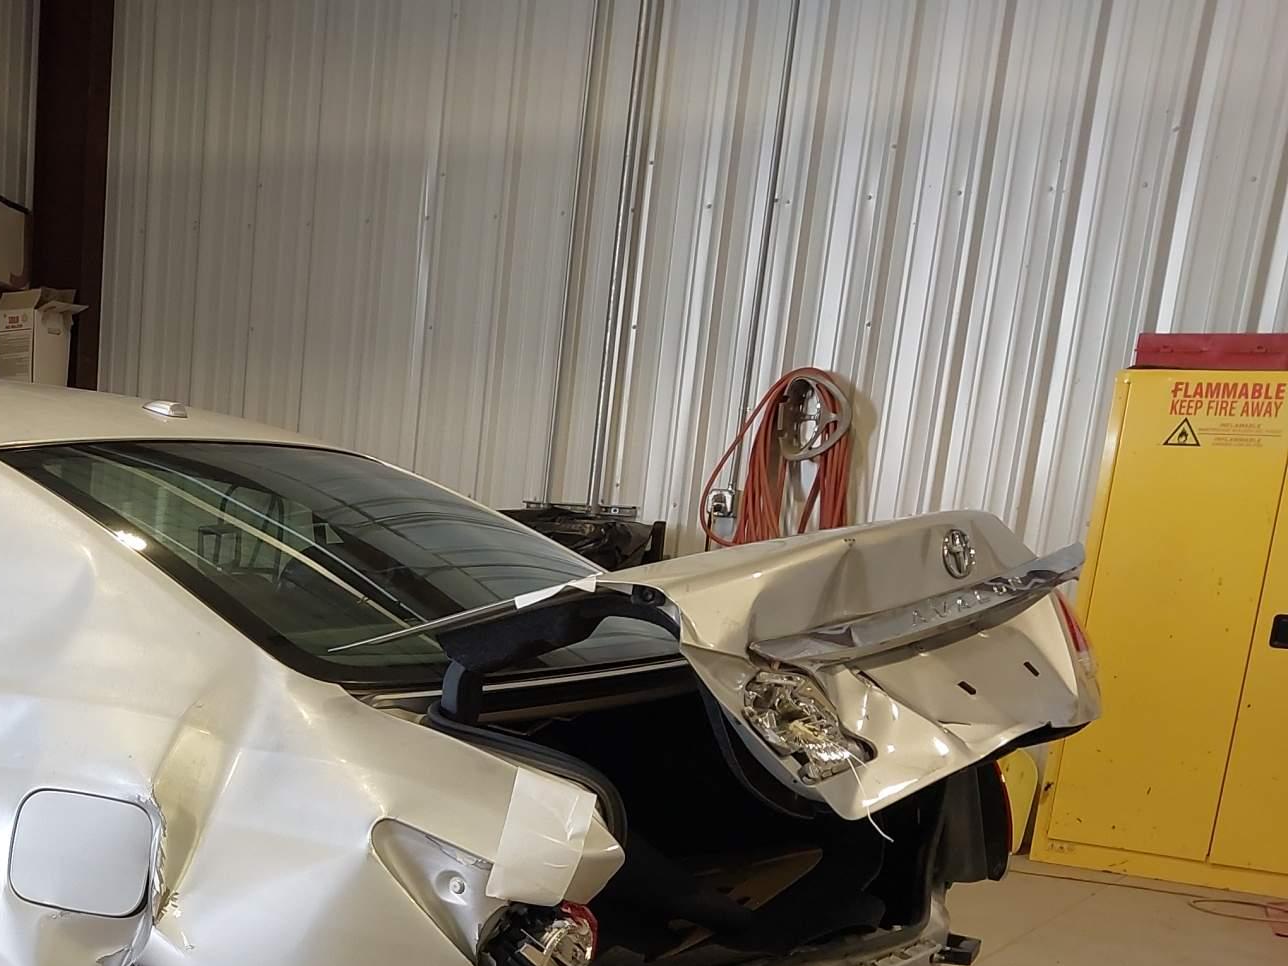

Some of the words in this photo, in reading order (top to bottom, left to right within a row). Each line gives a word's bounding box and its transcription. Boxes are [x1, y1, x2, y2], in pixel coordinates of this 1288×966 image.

[1171, 381, 1287, 400] FLAMMABLE
[1169, 399, 1203, 416] KEEP
[1206, 400, 1237, 417] FIRE
[1240, 401, 1283, 418] AWAY
